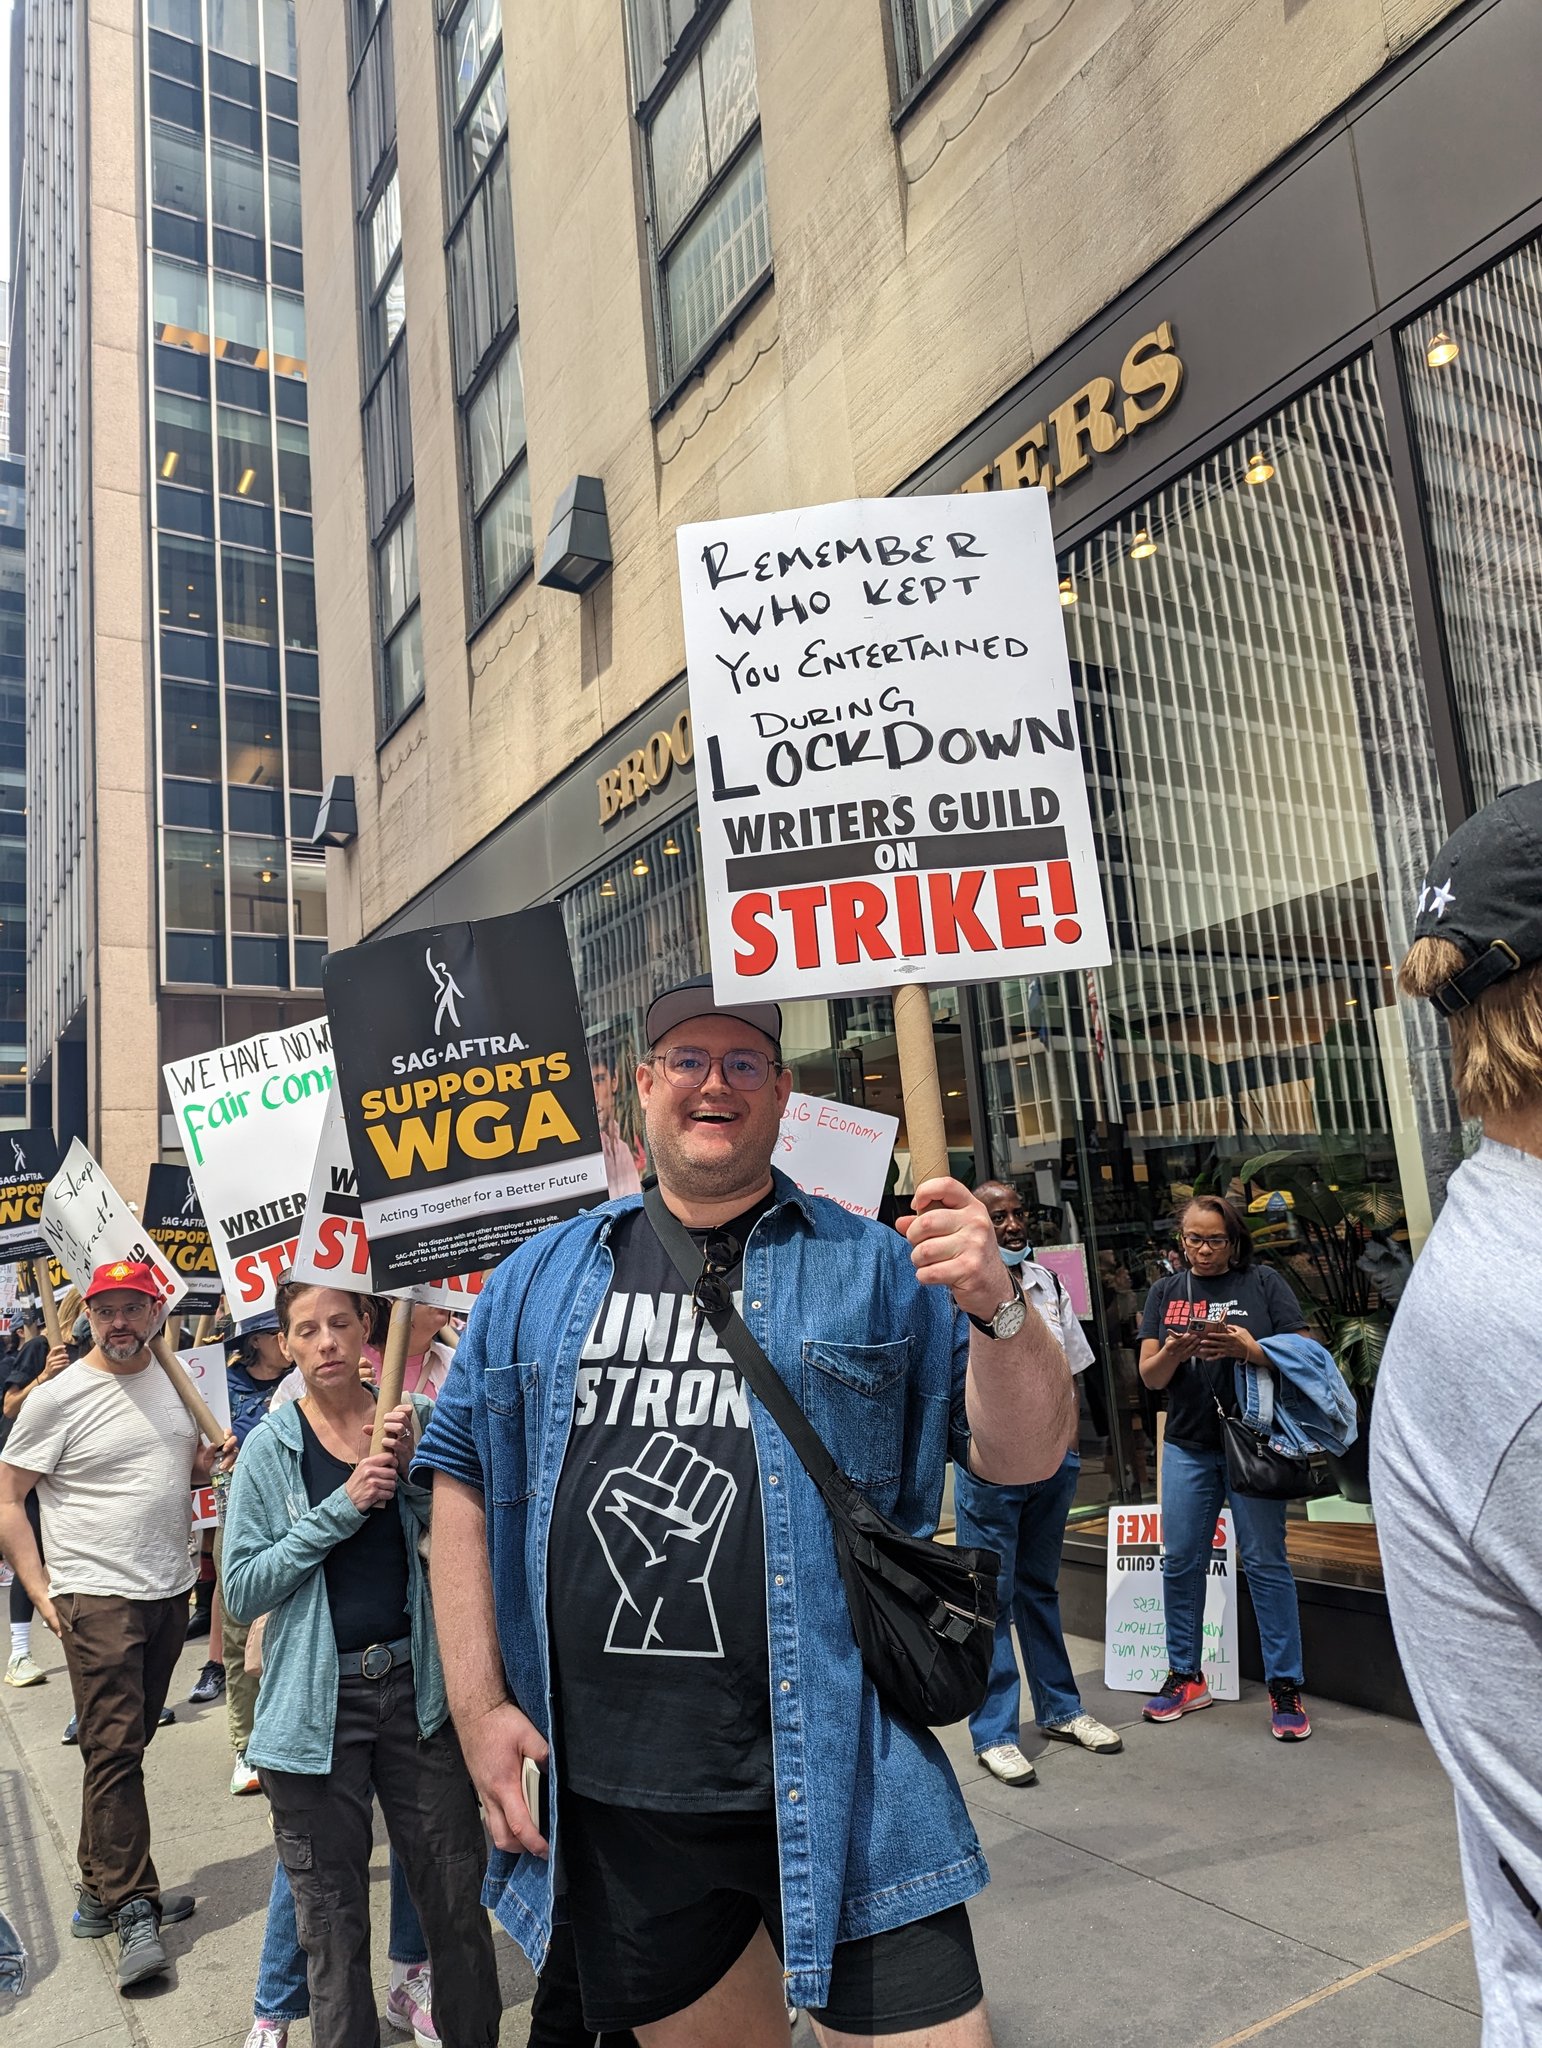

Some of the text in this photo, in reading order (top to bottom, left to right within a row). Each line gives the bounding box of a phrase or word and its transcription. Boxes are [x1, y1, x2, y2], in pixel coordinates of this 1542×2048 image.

[701, 532, 989, 590] REMEMBER
[719, 575, 982, 636] WHO KEPT
[798, 634, 1030, 678] ENTERTAINED
[750, 686, 915, 739] DURING
[596, 708, 694, 826] BROO
[706, 709, 1077, 801] LOCKDOWN
[723, 787, 1061, 856] WRITERS GUILD
[873, 842, 919, 872] ON
[731, 860, 1083, 978] STRIKE!
[170, 1058, 215, 1096] WE
[220, 1038, 278, 1083] HAVE
[280, 1032, 311, 1063] NO
[361, 1052, 571, 1120] SUPPORTS
[365, 1090, 581, 1180] WGA
[0, 1182, 49, 1200] UPPORT
[54, 1161, 93, 1209] Sleep
[379, 1171, 589, 1224] Acting Together for a Better Future
[45, 1216, 64, 1252] No
[147, 1229, 211, 1244] SUPPORT
[219, 1192, 307, 1239] WRITER
[428, 1236, 453, 1246] dispute
[453, 1232, 466, 1241] with
[475, 1226, 493, 1235] other
[493, 1220, 524, 1232] employer
[525, 1219, 533, 1227] at
[533, 1216, 546, 1225] this
[437, 1244, 449, 1252] not
[450, 1239, 468, 1250] asking
[478, 1231, 510, 1242] individual
[518, 1227, 537, 1235] cease
[412, 1256, 420, 1264] or
[428, 1251, 450, 1261] refuse
[1209, 1300, 1238, 1308] WRITERS
[575, 1366, 750, 1429] STRON
[1117, 1556, 1155, 1572] GUILD
